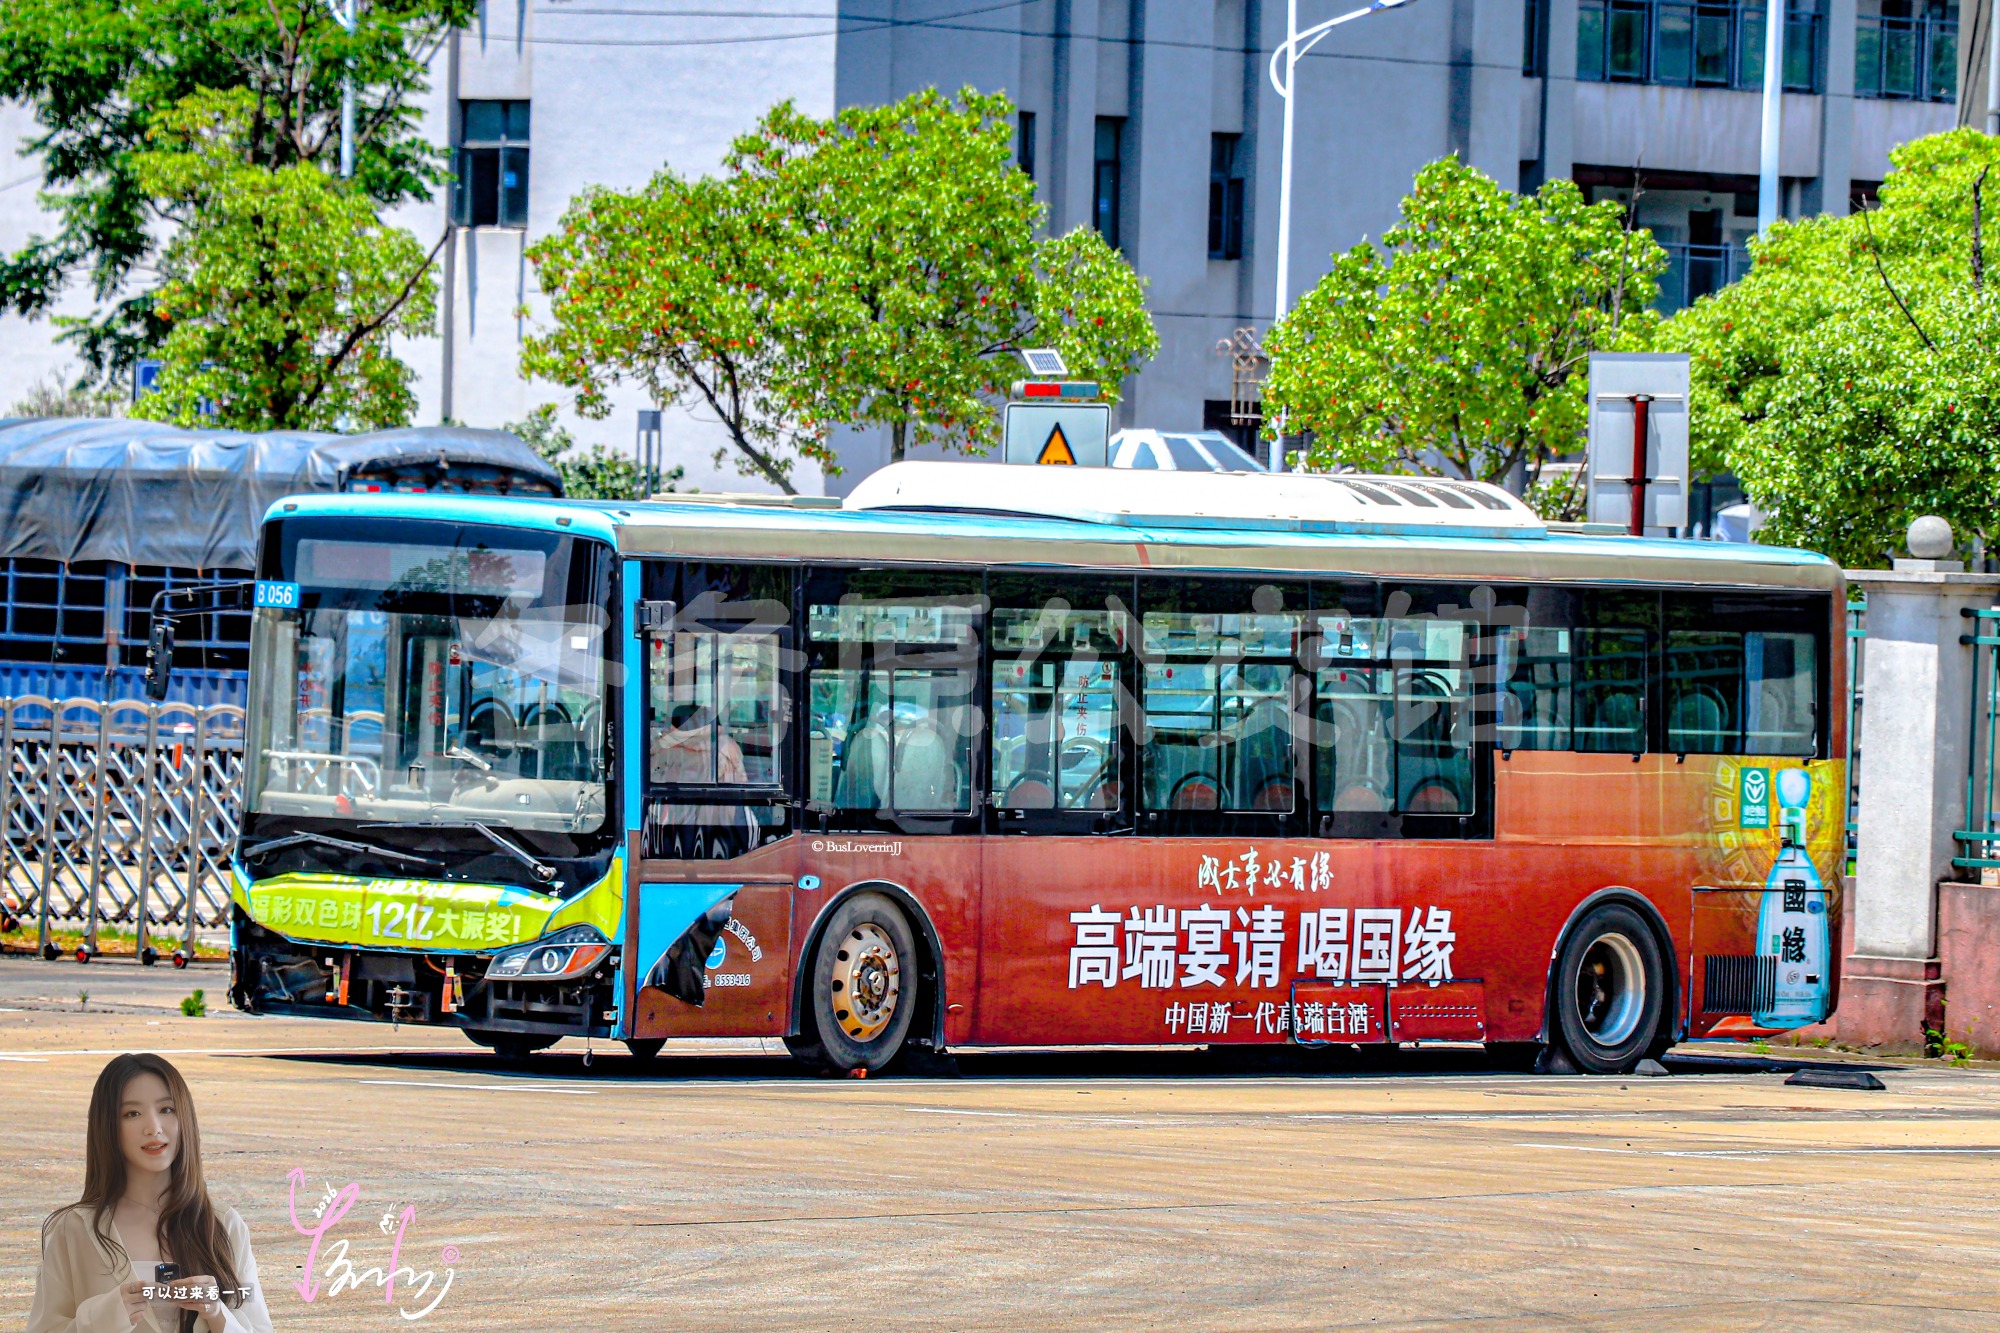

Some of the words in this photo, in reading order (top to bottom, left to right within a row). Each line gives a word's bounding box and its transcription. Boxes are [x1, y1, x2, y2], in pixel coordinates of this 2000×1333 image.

[257, 583, 266, 602] B
[268, 584, 293, 605] 056
[1076, 675, 1090, 736] 防止夹伤
[1197, 846, 1334, 897] 成大事必有缘
[1068, 903, 1286, 989] 高端宴请
[1297, 905, 1456, 988] 喝国缘
[714, 973, 751, 987] 8553416
[1164, 1001, 1369, 1035] 中国新一代高端白酒
